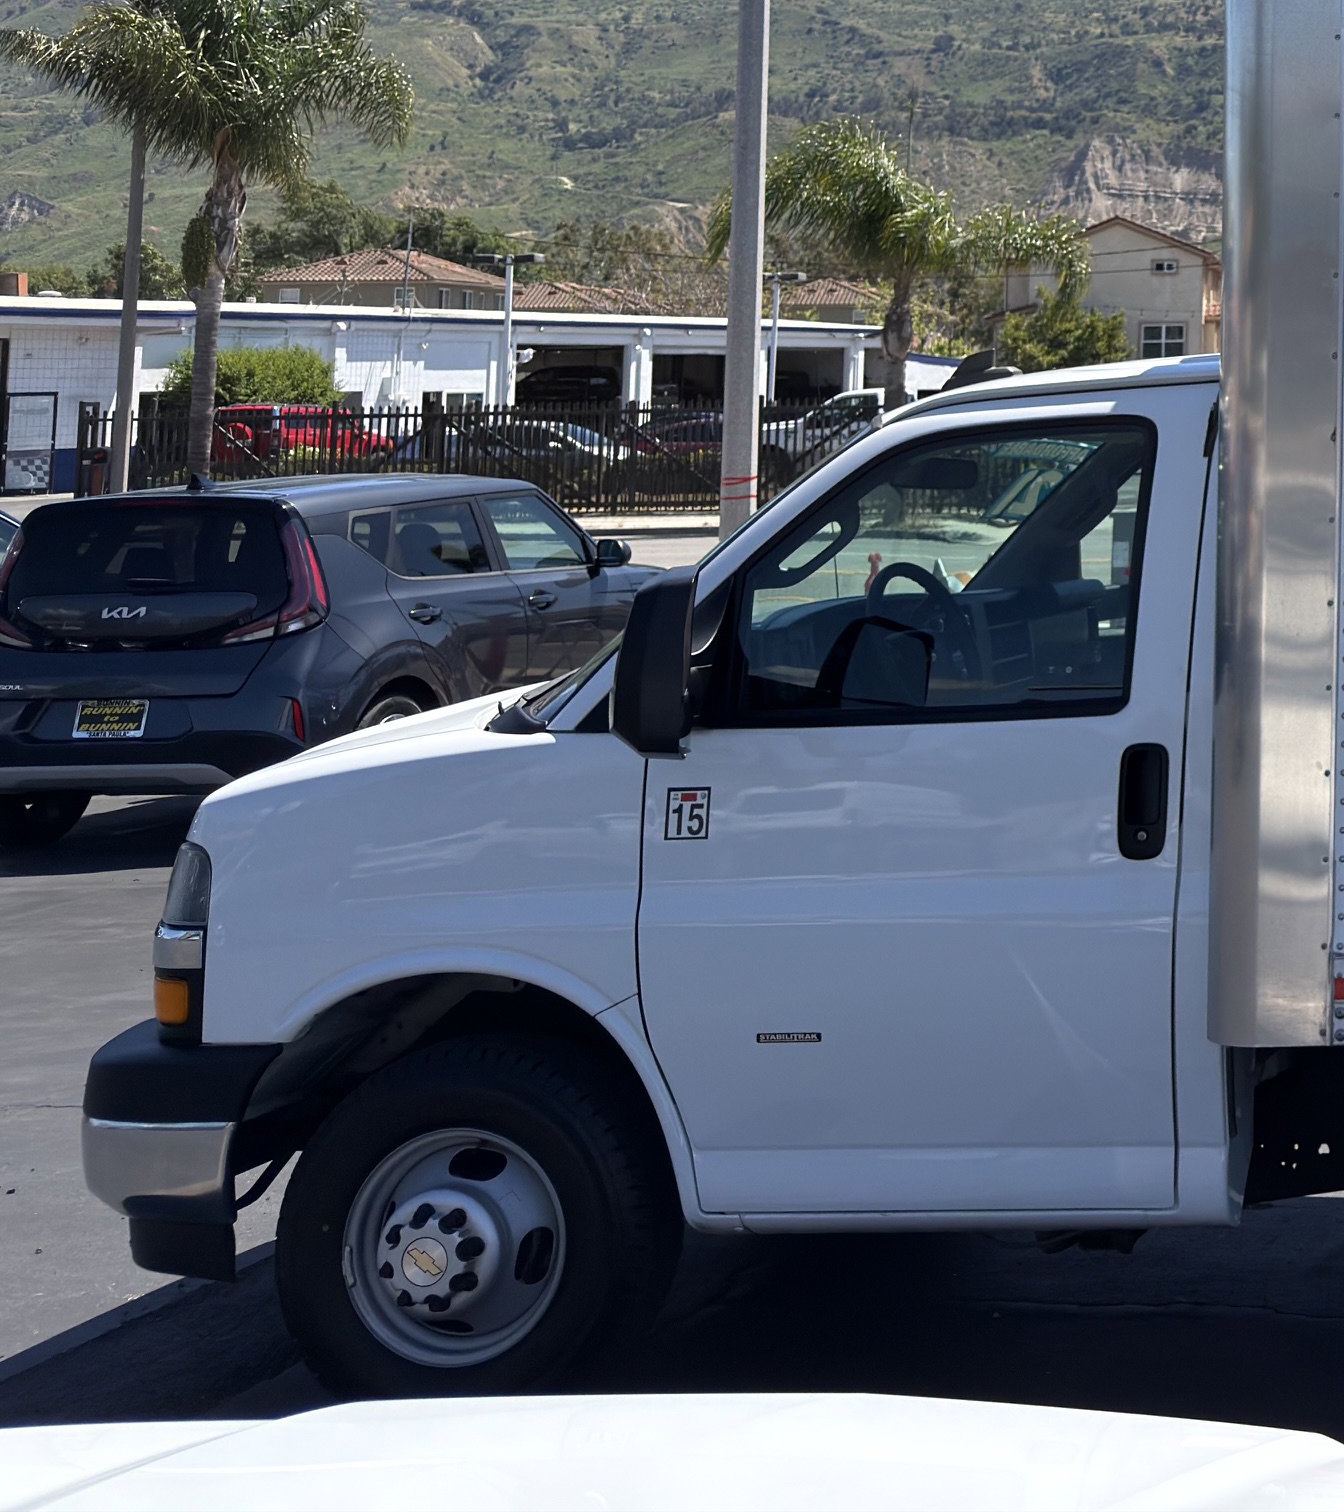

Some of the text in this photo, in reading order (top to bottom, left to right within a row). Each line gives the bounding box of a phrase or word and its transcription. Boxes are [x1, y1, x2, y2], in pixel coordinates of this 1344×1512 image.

[101, 606, 147, 619] KIA
[79, 722, 139, 731] BUNNIN
[672, 803, 704, 836] 15
[760, 1033, 818, 1042] STABILITRAK
